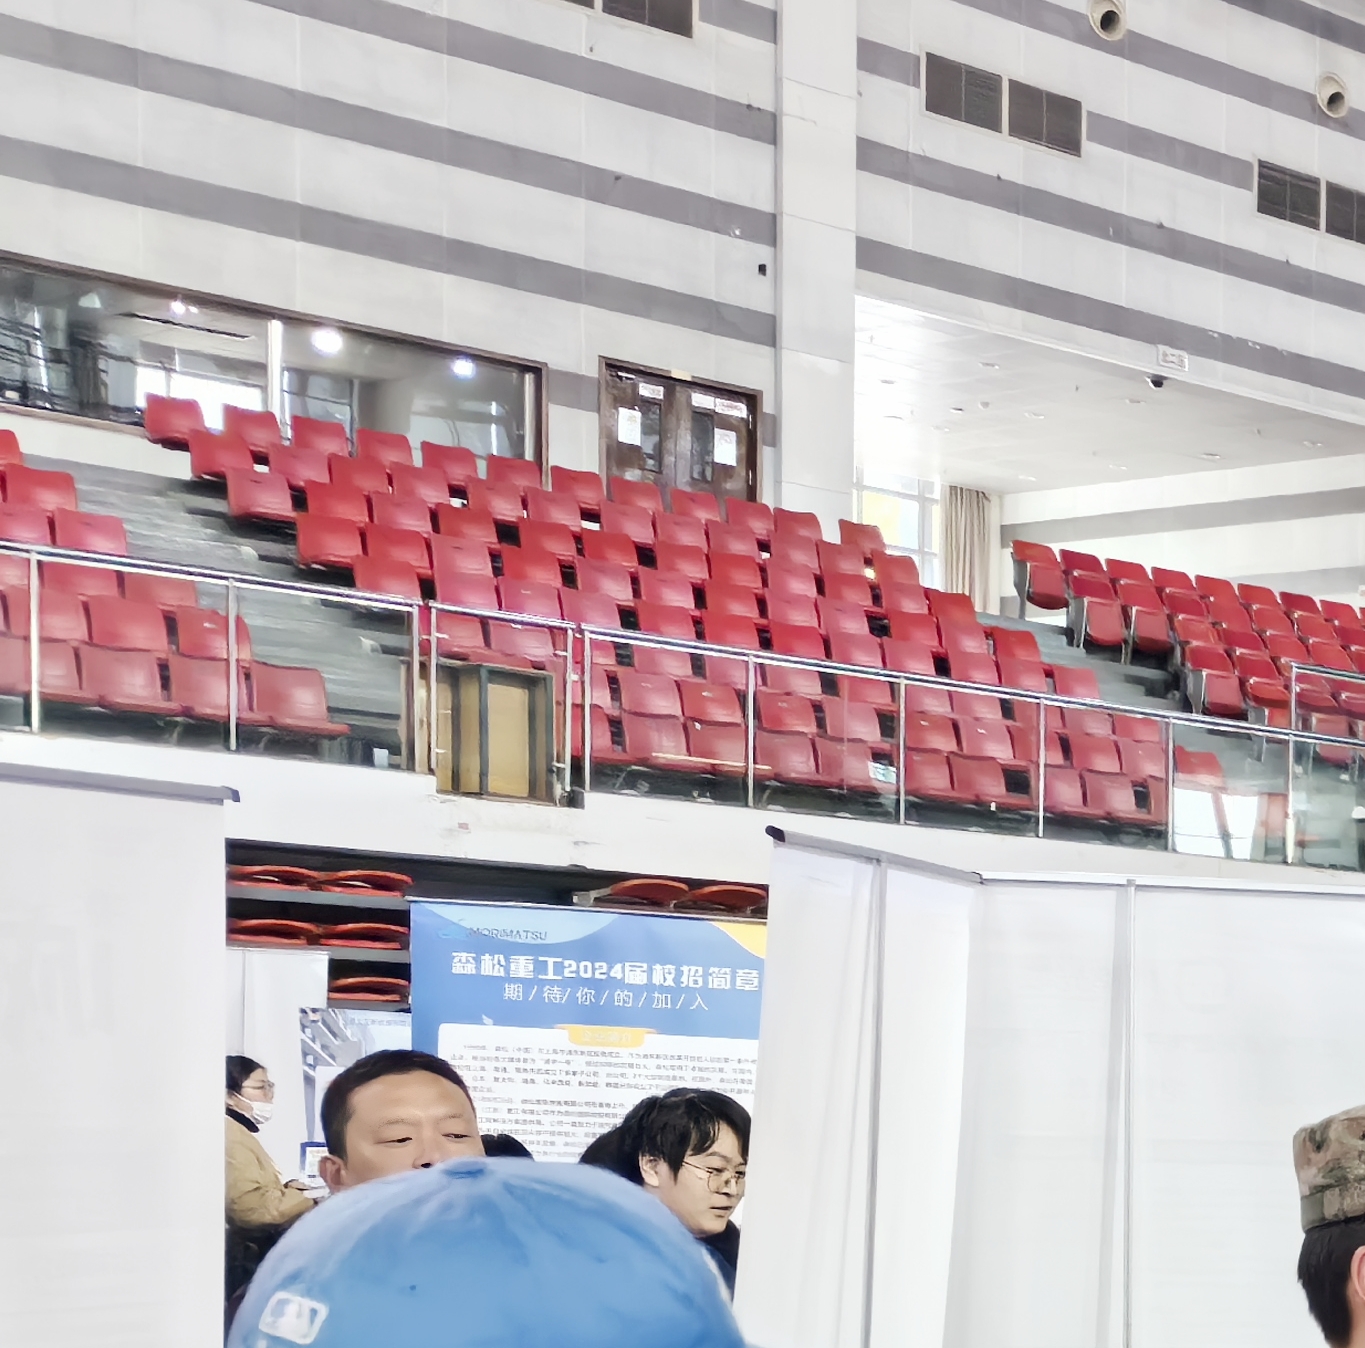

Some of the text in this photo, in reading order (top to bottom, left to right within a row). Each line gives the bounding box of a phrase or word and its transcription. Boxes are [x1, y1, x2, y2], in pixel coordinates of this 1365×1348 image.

[451, 951, 760, 991] 森松重工2024届校招简章
